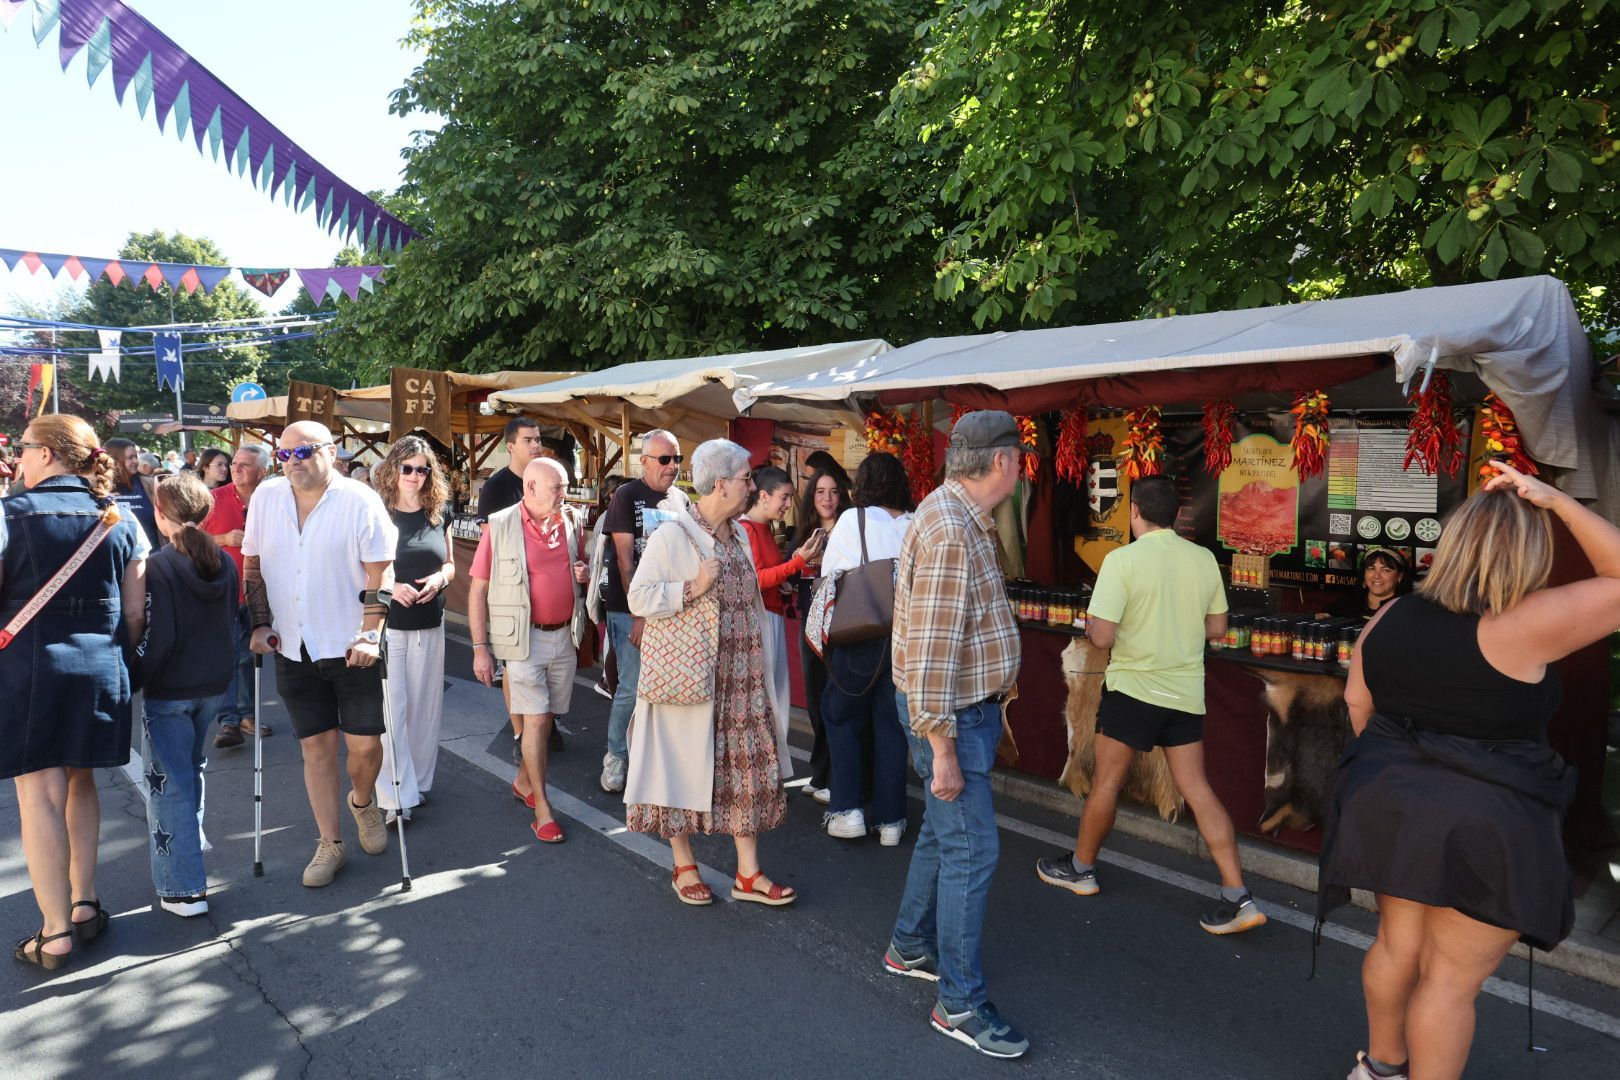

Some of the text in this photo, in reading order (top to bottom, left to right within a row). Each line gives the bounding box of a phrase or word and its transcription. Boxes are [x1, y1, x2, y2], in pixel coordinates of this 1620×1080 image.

[405, 378, 436, 395] CA
[296, 394, 328, 414] TÉ
[405, 396, 436, 414] FÉ
[1233, 455, 1287, 468] MARTÍNEZ
[14, 577, 64, 628] CASADEMUNT
